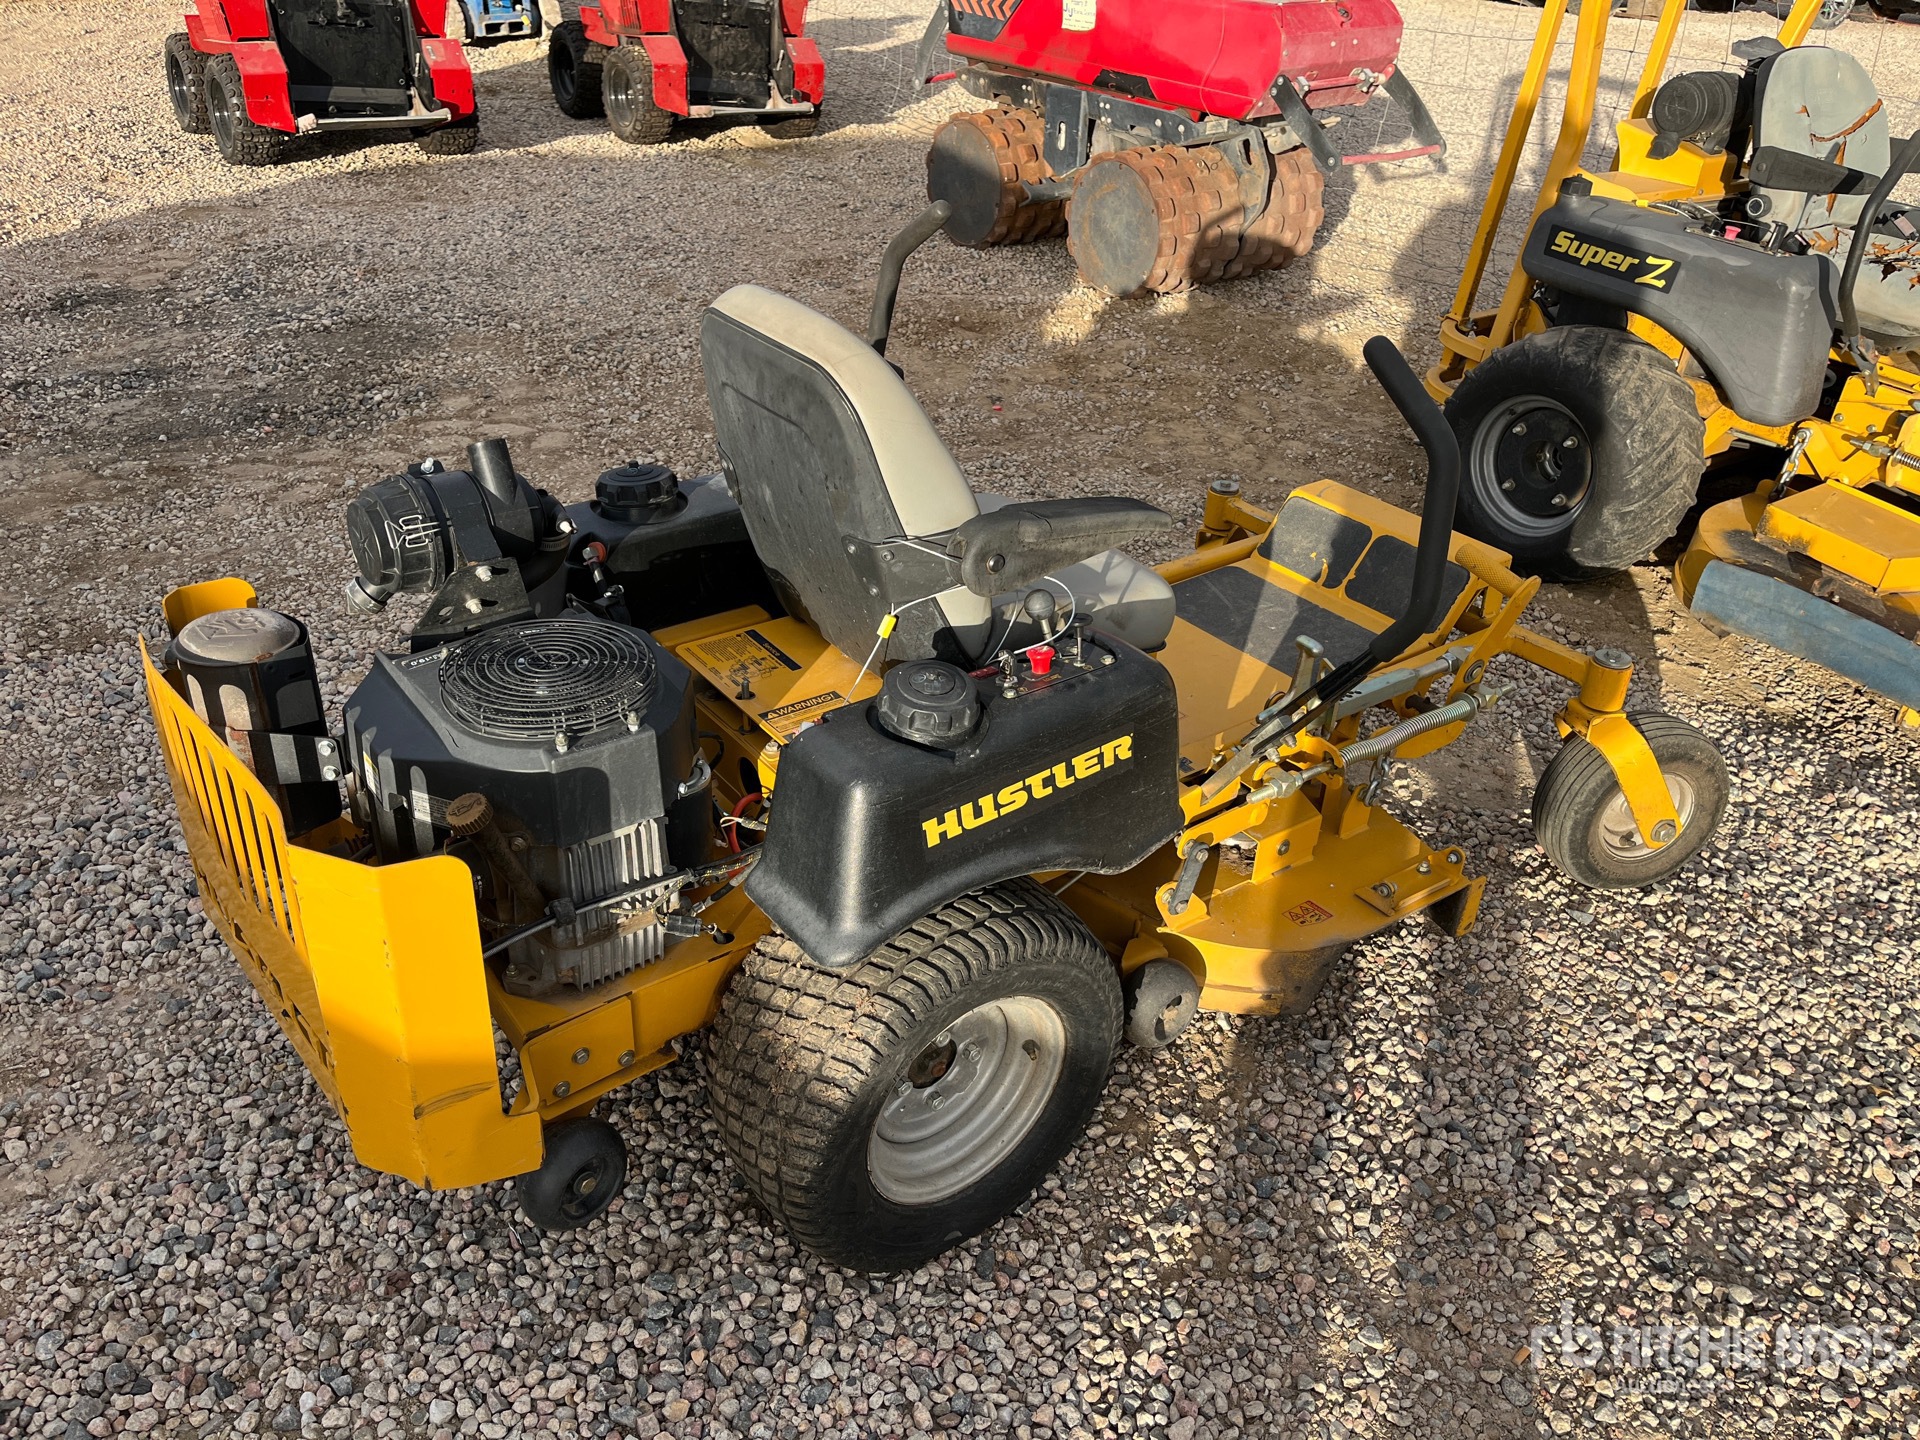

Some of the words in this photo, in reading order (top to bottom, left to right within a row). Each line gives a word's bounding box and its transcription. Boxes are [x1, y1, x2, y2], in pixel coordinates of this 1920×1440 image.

[1551, 230, 1640, 272] Super
[1634, 255, 1675, 289] Z
[921, 734, 1133, 849] HUSTLER
